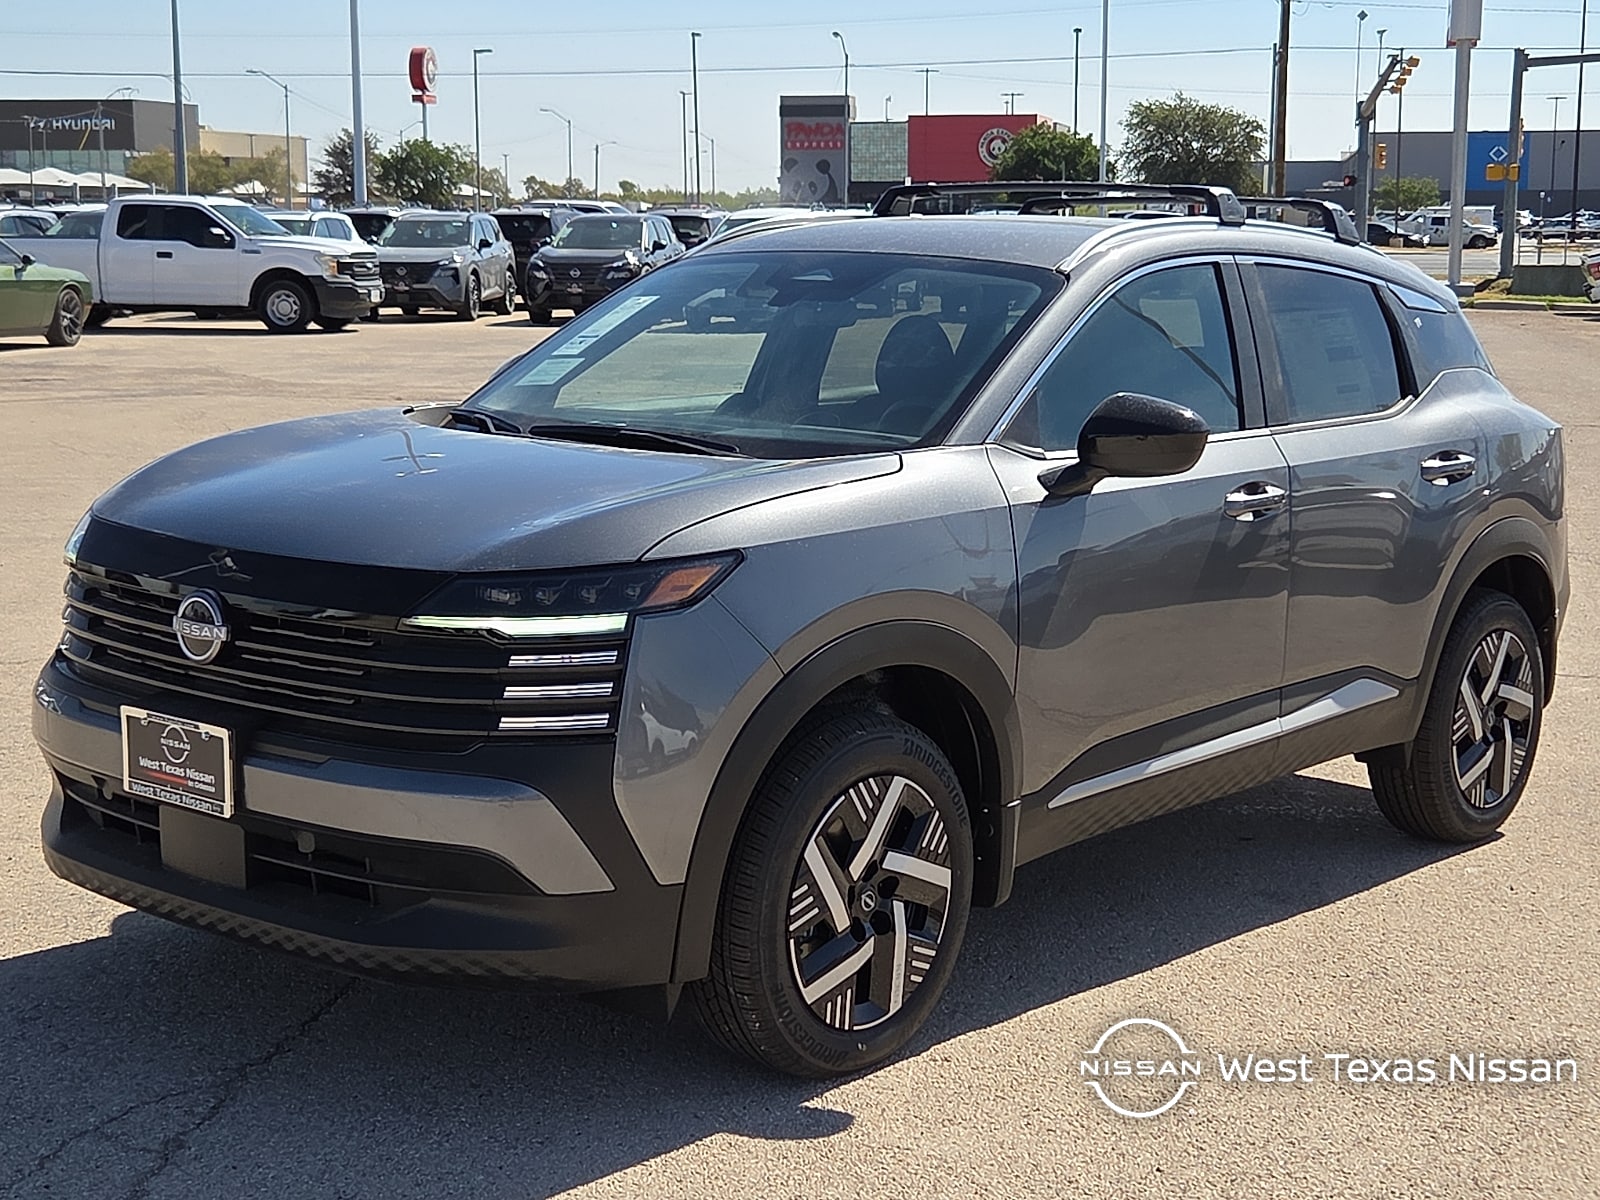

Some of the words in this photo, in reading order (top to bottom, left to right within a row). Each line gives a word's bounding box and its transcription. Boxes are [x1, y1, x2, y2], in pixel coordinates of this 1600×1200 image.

[53, 119, 115, 130] HYUNDAI
[785, 122, 844, 139] PANDA
[786, 140, 842, 149] EXPRESS
[160, 738, 191, 751] NISSAN
[139, 756, 160, 771] West
[161, 762, 185, 777] Texas
[186, 768, 215, 784] Nissan
[902, 737, 968, 829] BRIDGESTONE
[132, 782, 153, 796] West
[154, 788, 181, 803] Texas
[183, 796, 212, 811] Nissan
[778, 981, 849, 1068] BRIDGESTONE
